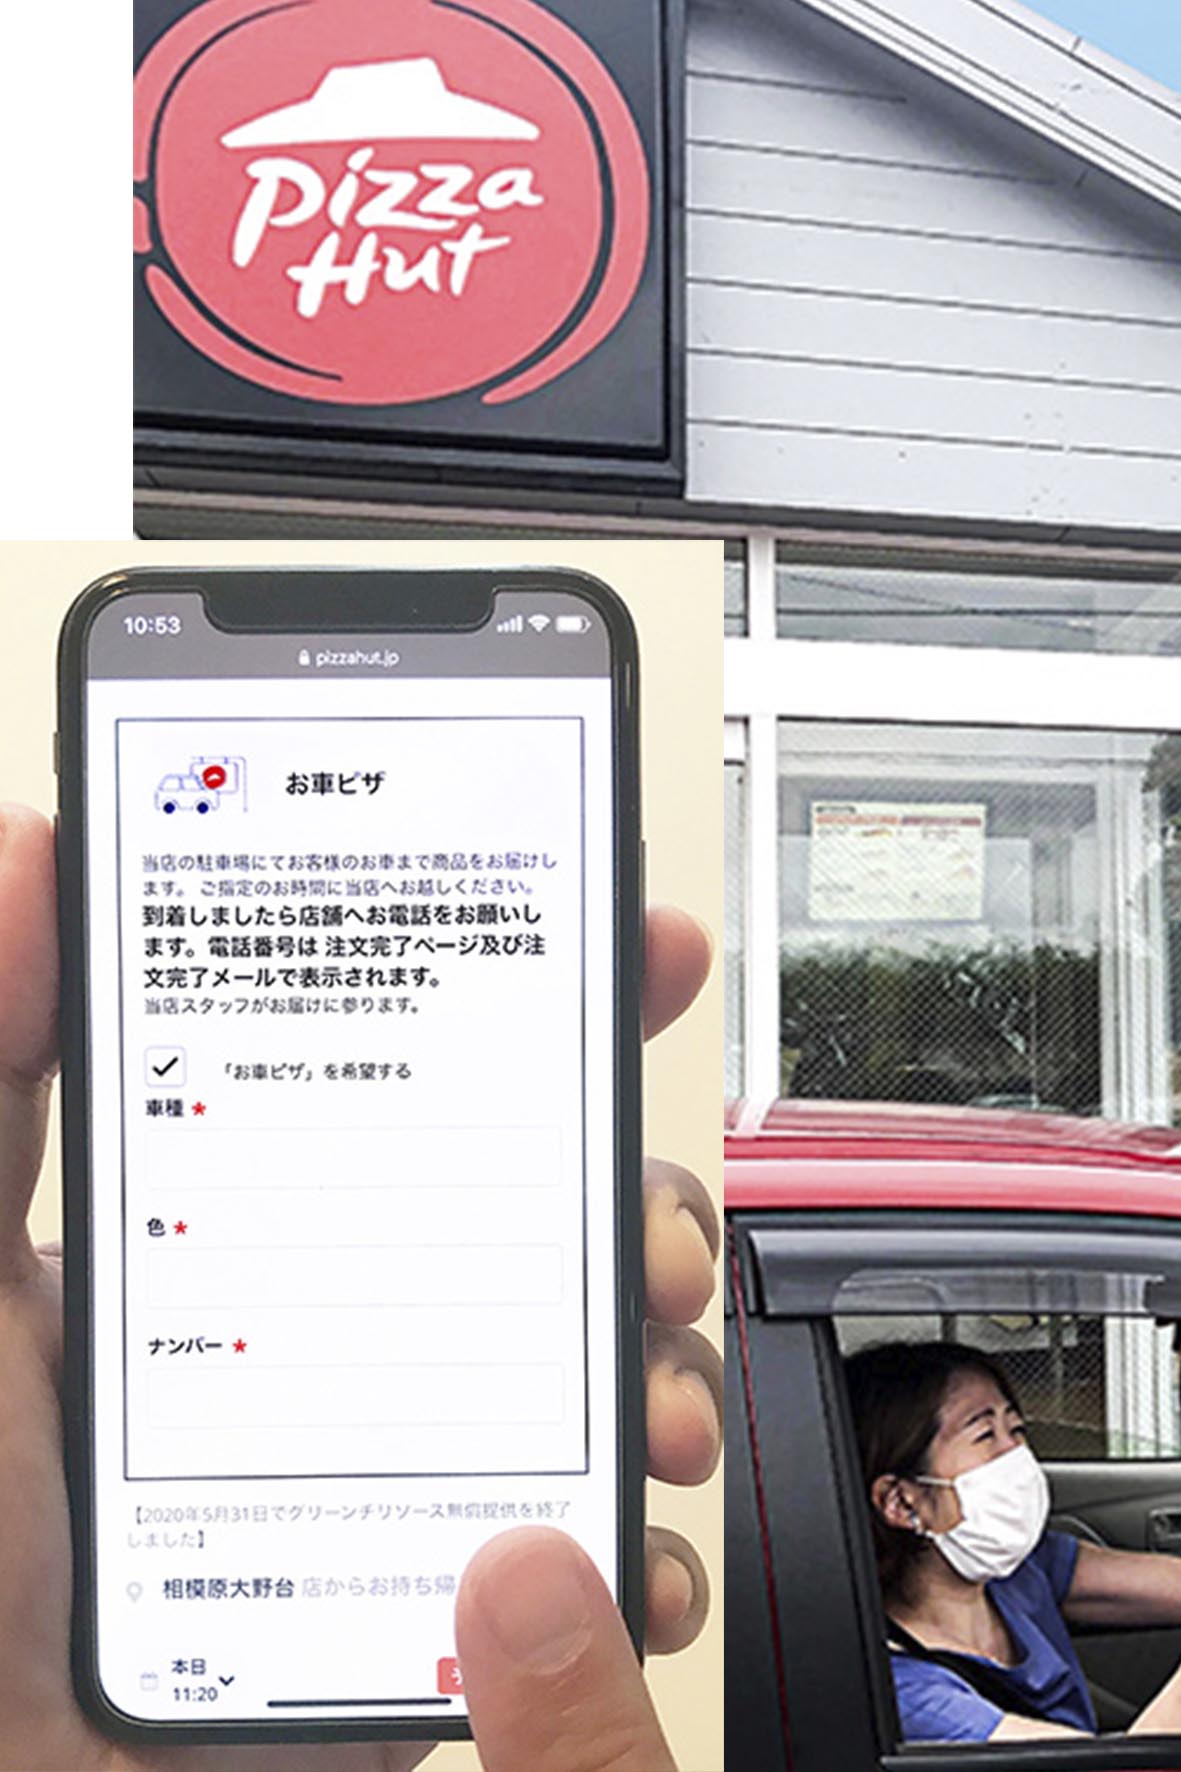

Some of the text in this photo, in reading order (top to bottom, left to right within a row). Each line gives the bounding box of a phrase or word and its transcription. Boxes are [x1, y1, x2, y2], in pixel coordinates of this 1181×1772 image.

[232, 147, 544, 268] Pizza
[286, 223, 511, 318] Hut
[124, 616, 181, 635] 10:53
[316, 650, 399, 668] pizzahut.jp
[285, 771, 386, 796] お車ピザ
[142, 903, 541, 927] 到着しましたら店舗へお電話をお願いし
[144, 966, 439, 989] 文完了メールで表示されます。
[145, 997, 418, 1015] 当店スタッフがお届けに参ります。
[146, 1099, 184, 1118] 車種
[146, 1218, 167, 1238] 色
[148, 1336, 223, 1356] ナンバー
[172, 1659, 206, 1675] 本日
[173, 1687, 218, 1702] 11:20
